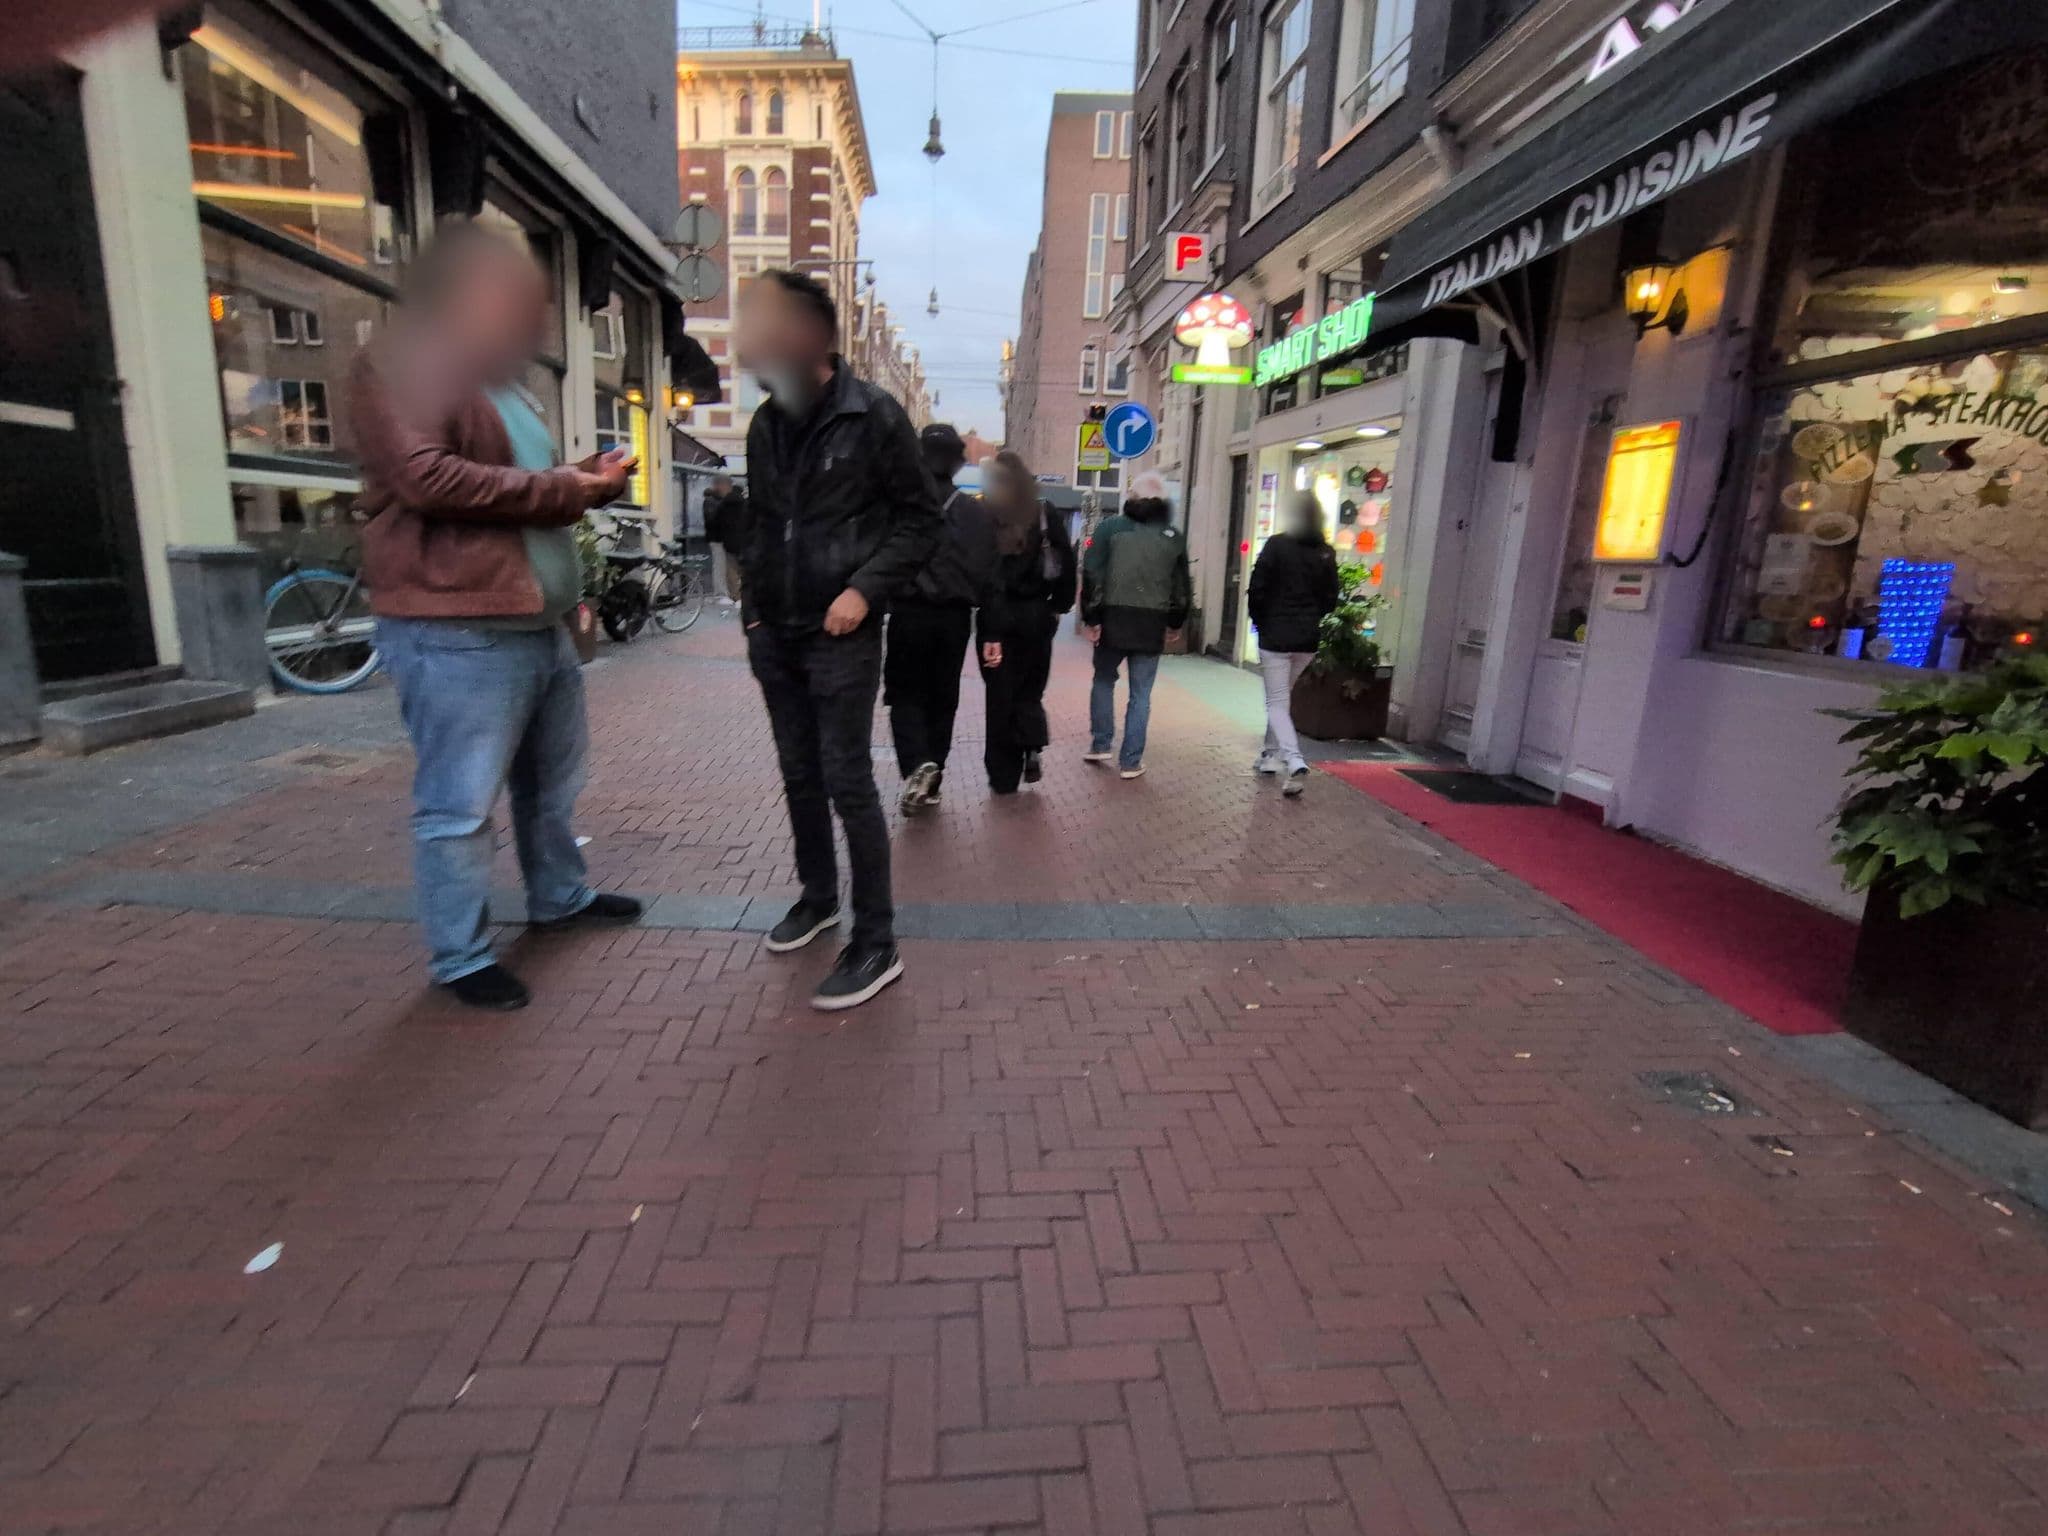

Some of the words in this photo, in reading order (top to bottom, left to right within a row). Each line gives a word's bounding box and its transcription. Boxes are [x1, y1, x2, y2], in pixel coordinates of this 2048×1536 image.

[1422, 218, 1543, 309] ITALIAN
[1562, 92, 1777, 242] CUISINE
[1176, 236, 1202, 271] F
[1255, 322, 1318, 388] SMART
